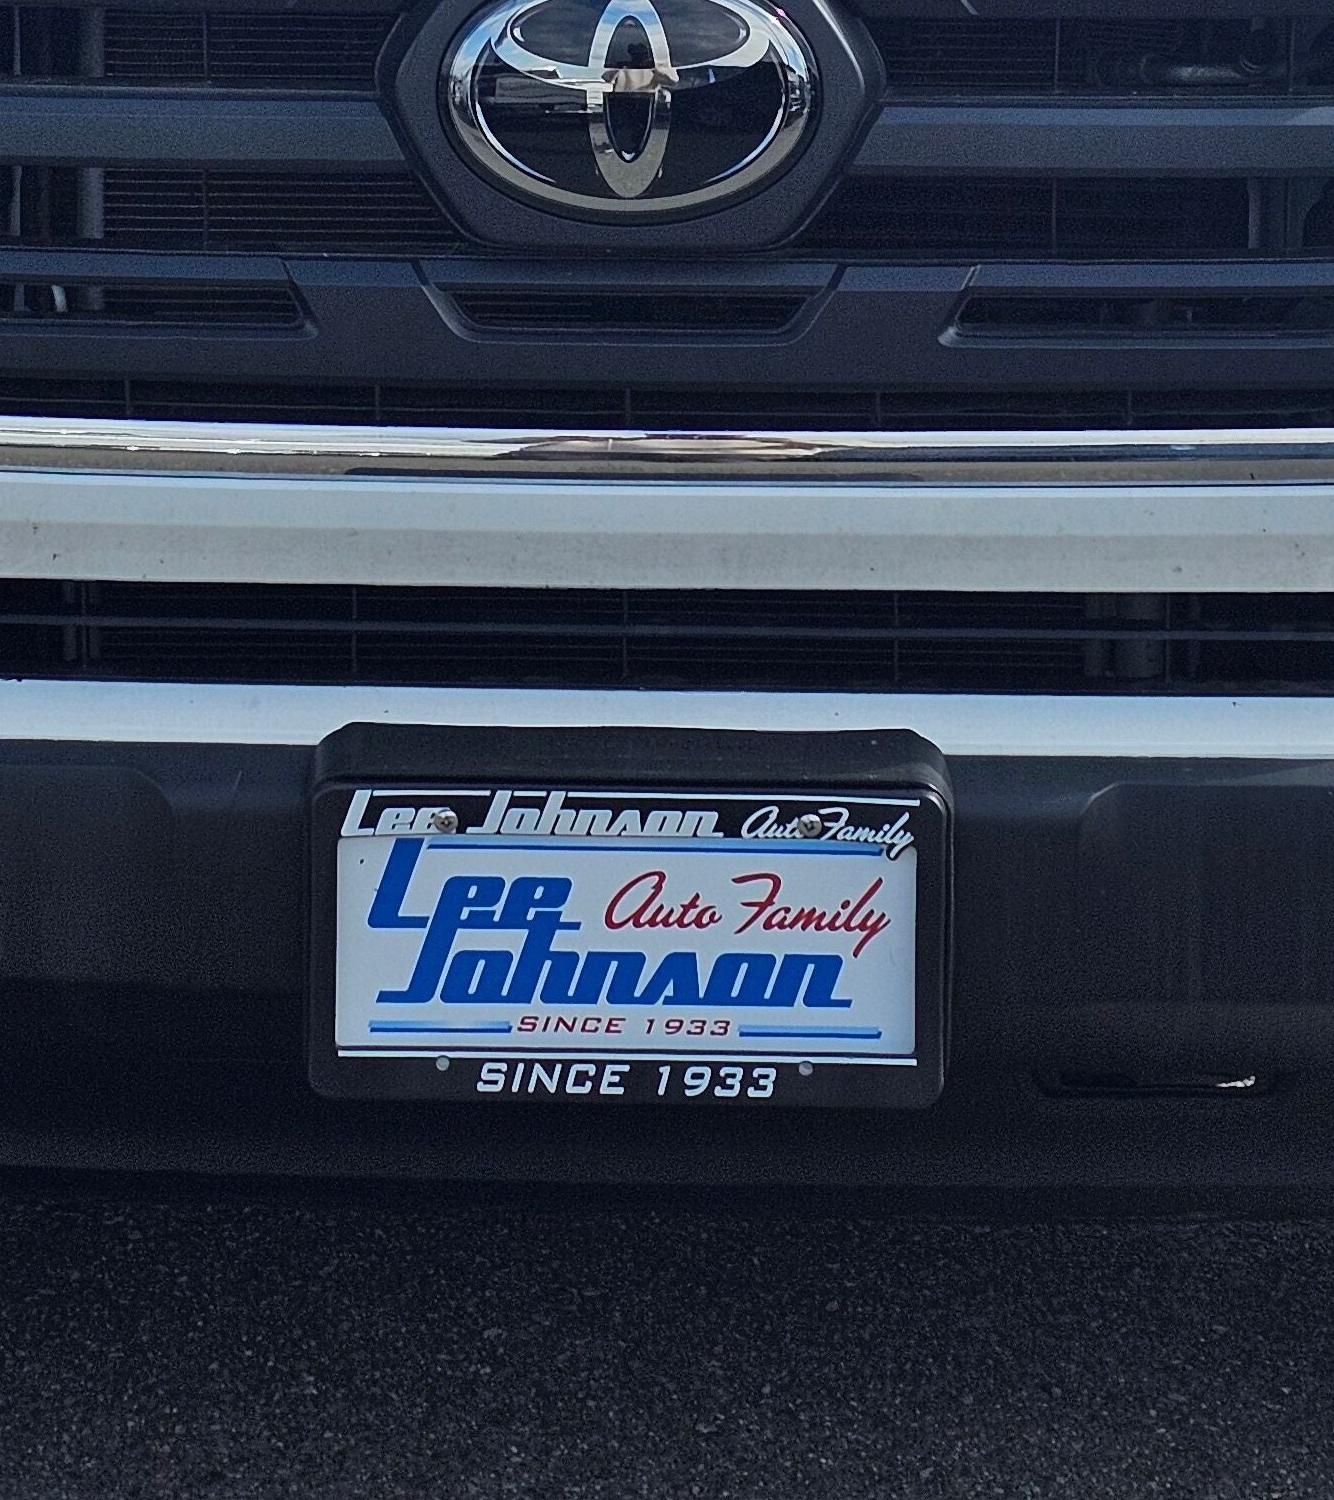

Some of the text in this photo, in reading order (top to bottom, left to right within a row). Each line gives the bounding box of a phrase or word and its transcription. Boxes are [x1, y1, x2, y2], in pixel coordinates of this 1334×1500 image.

[340, 789, 457, 836] Lee
[467, 791, 724, 838] Johnson
[820, 807, 915, 860] Family
[368, 838, 891, 958] Lee Auto Family
[376, 910, 853, 1008] Johnson
[517, 1016, 731, 1036] SINCE 1933
[477, 1062, 777, 1098] SINCE 1933
